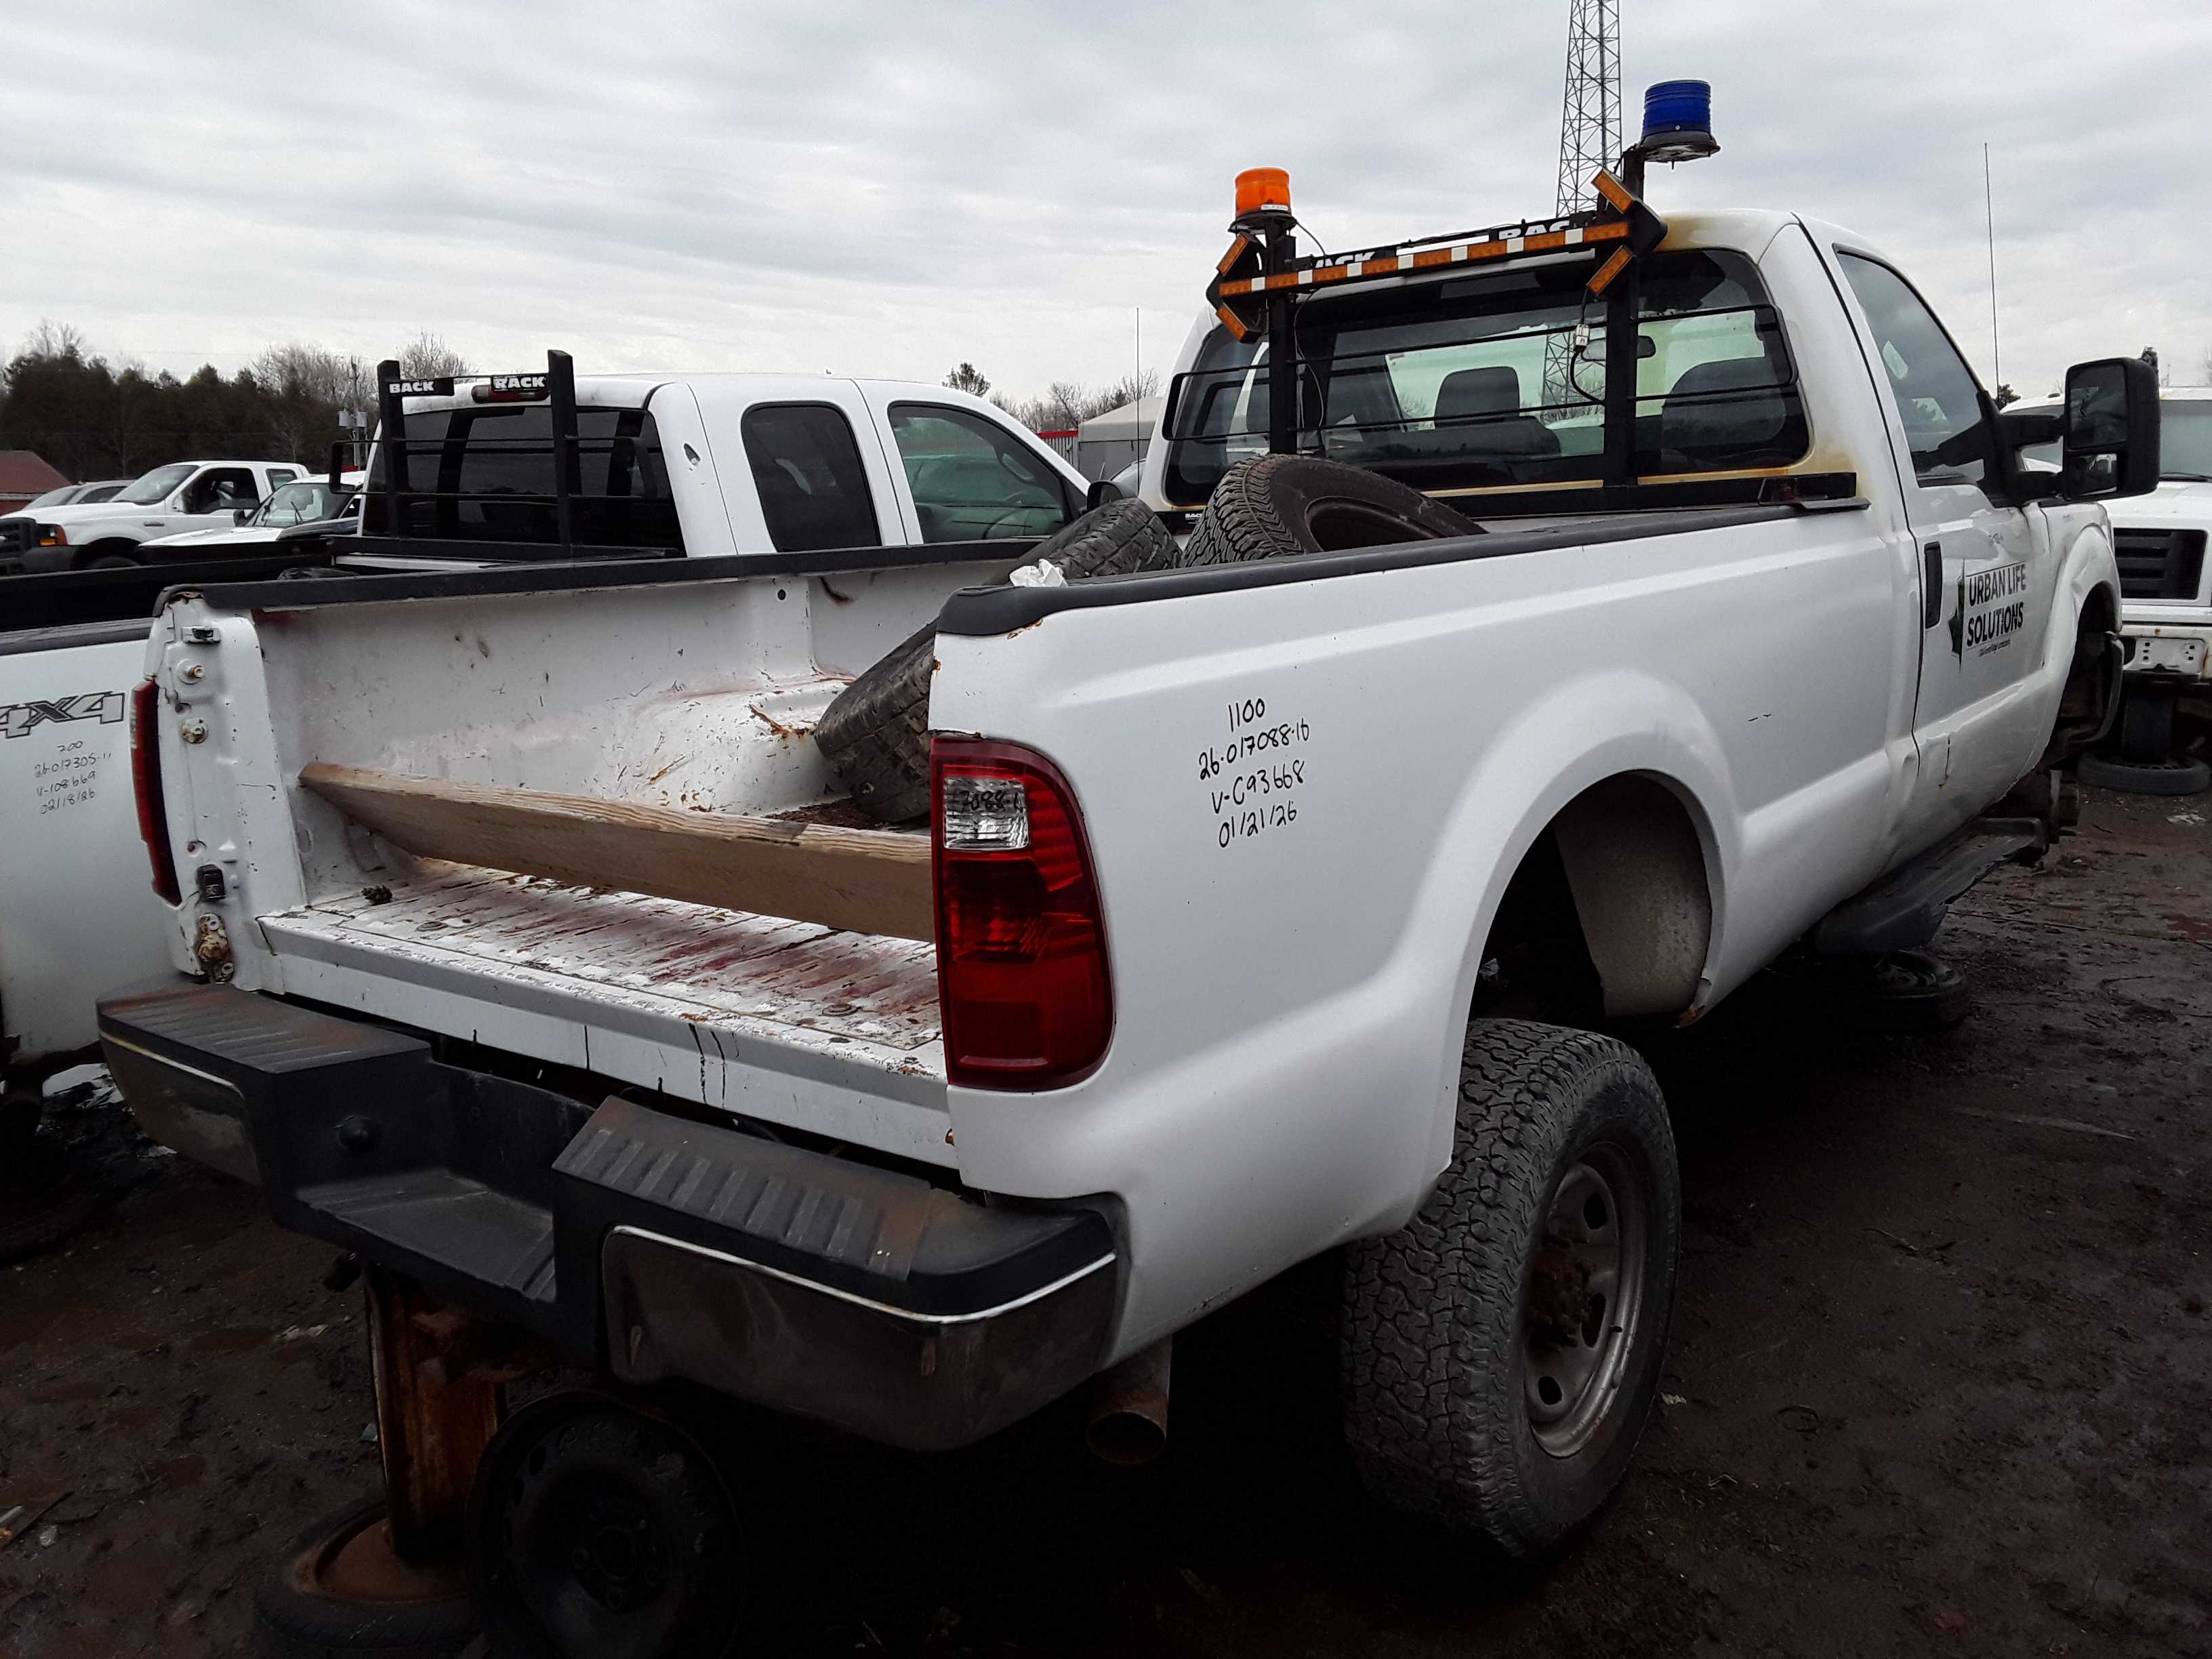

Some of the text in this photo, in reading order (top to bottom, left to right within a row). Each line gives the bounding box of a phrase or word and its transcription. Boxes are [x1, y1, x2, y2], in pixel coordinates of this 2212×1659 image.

[389, 376, 546, 394] BACK RACK
[1969, 563, 2026, 607] URBAN LIFE
[1967, 601, 2024, 647] SOLUTIONS
[1228, 698, 1265, 733] 1100
[1219, 800, 1297, 848] 01/21/26
